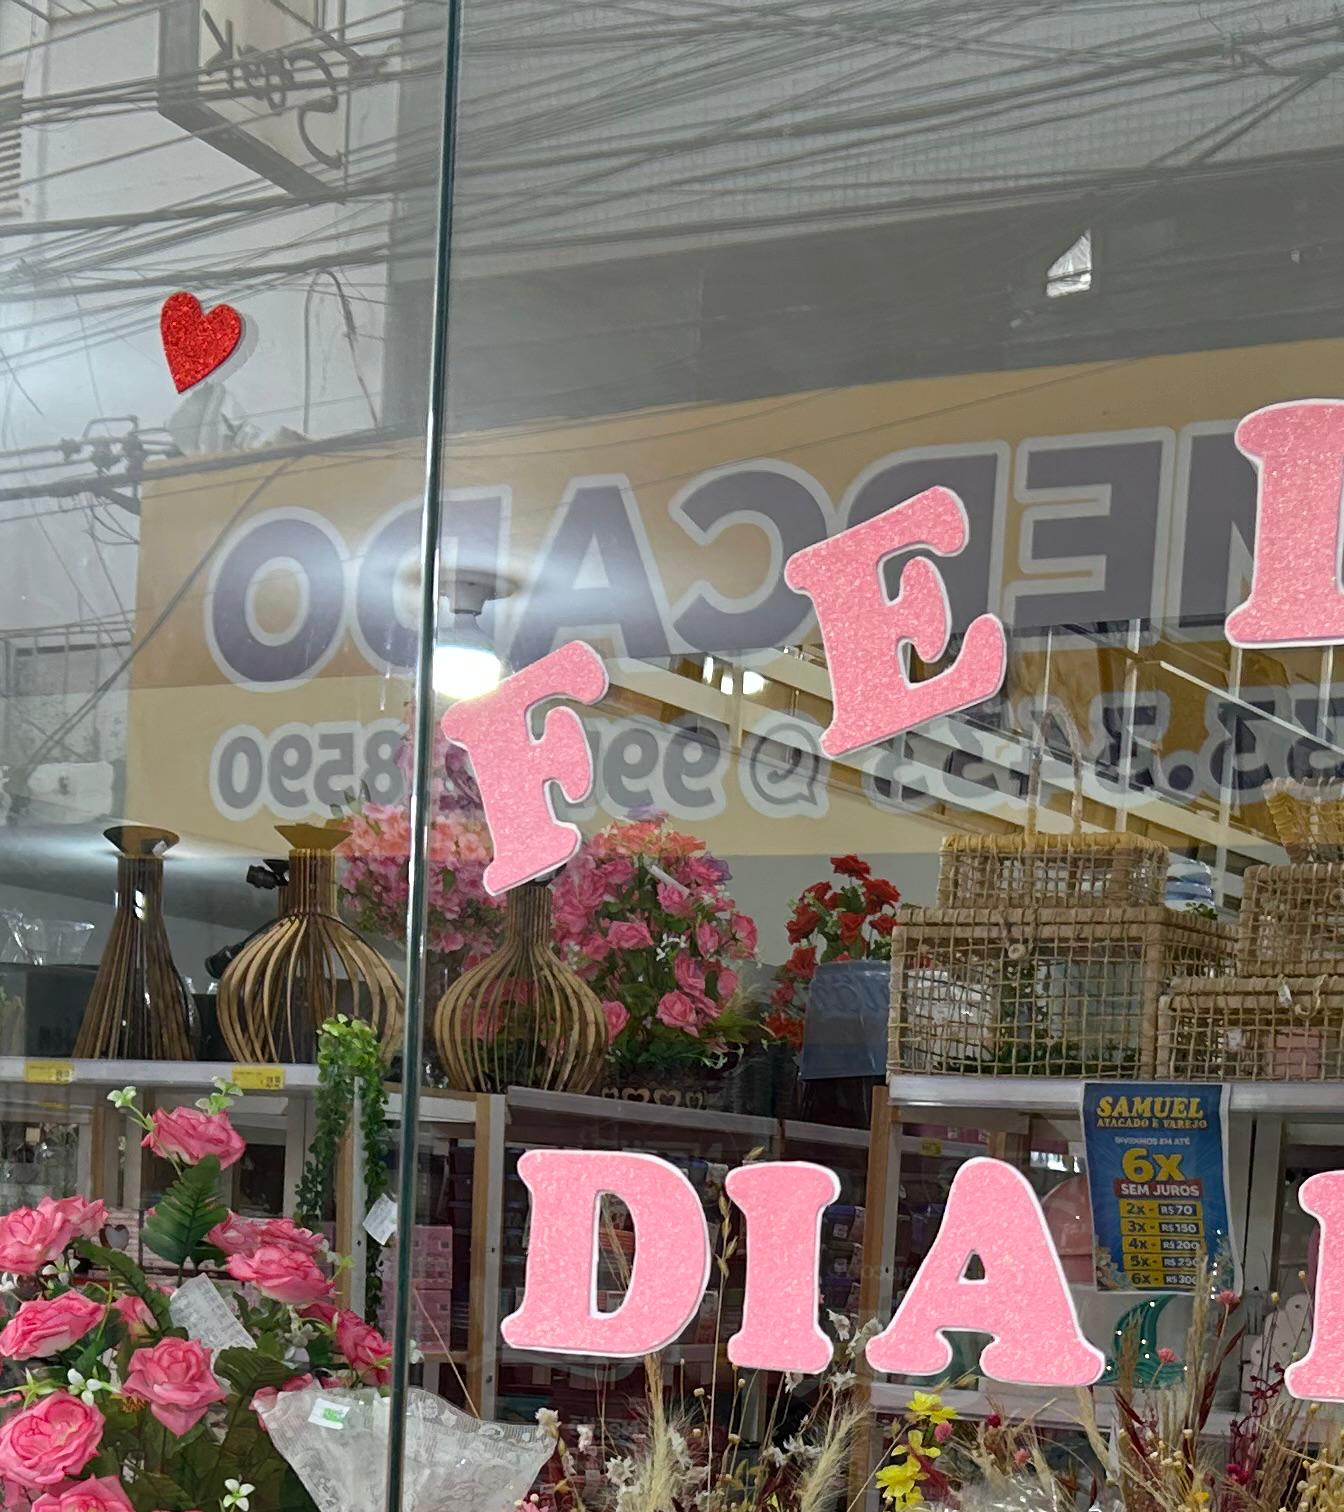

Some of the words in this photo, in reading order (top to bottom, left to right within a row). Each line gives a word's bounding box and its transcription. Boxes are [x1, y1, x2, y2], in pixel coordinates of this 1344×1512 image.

[1096, 1096, 1203, 1119] SAMUEL
[1096, 1118, 1149, 1128] ATACADO
[1163, 1119, 1208, 1130] VAREJO
[1173, 1135, 1191, 1146] ATÉ
[1122, 1148, 1185, 1183] 6x
[1120, 1184, 1149, 1196] SEM
[1153, 1185, 1200, 1197] JUROS
[1126, 1202, 1145, 1215] 2x
[1128, 1219, 1146, 1233] 3x
[1128, 1236, 1147, 1250] 4x
[496, 1144, 1107, 1390] DIA
[1132, 1272, 1151, 1285] 6x
